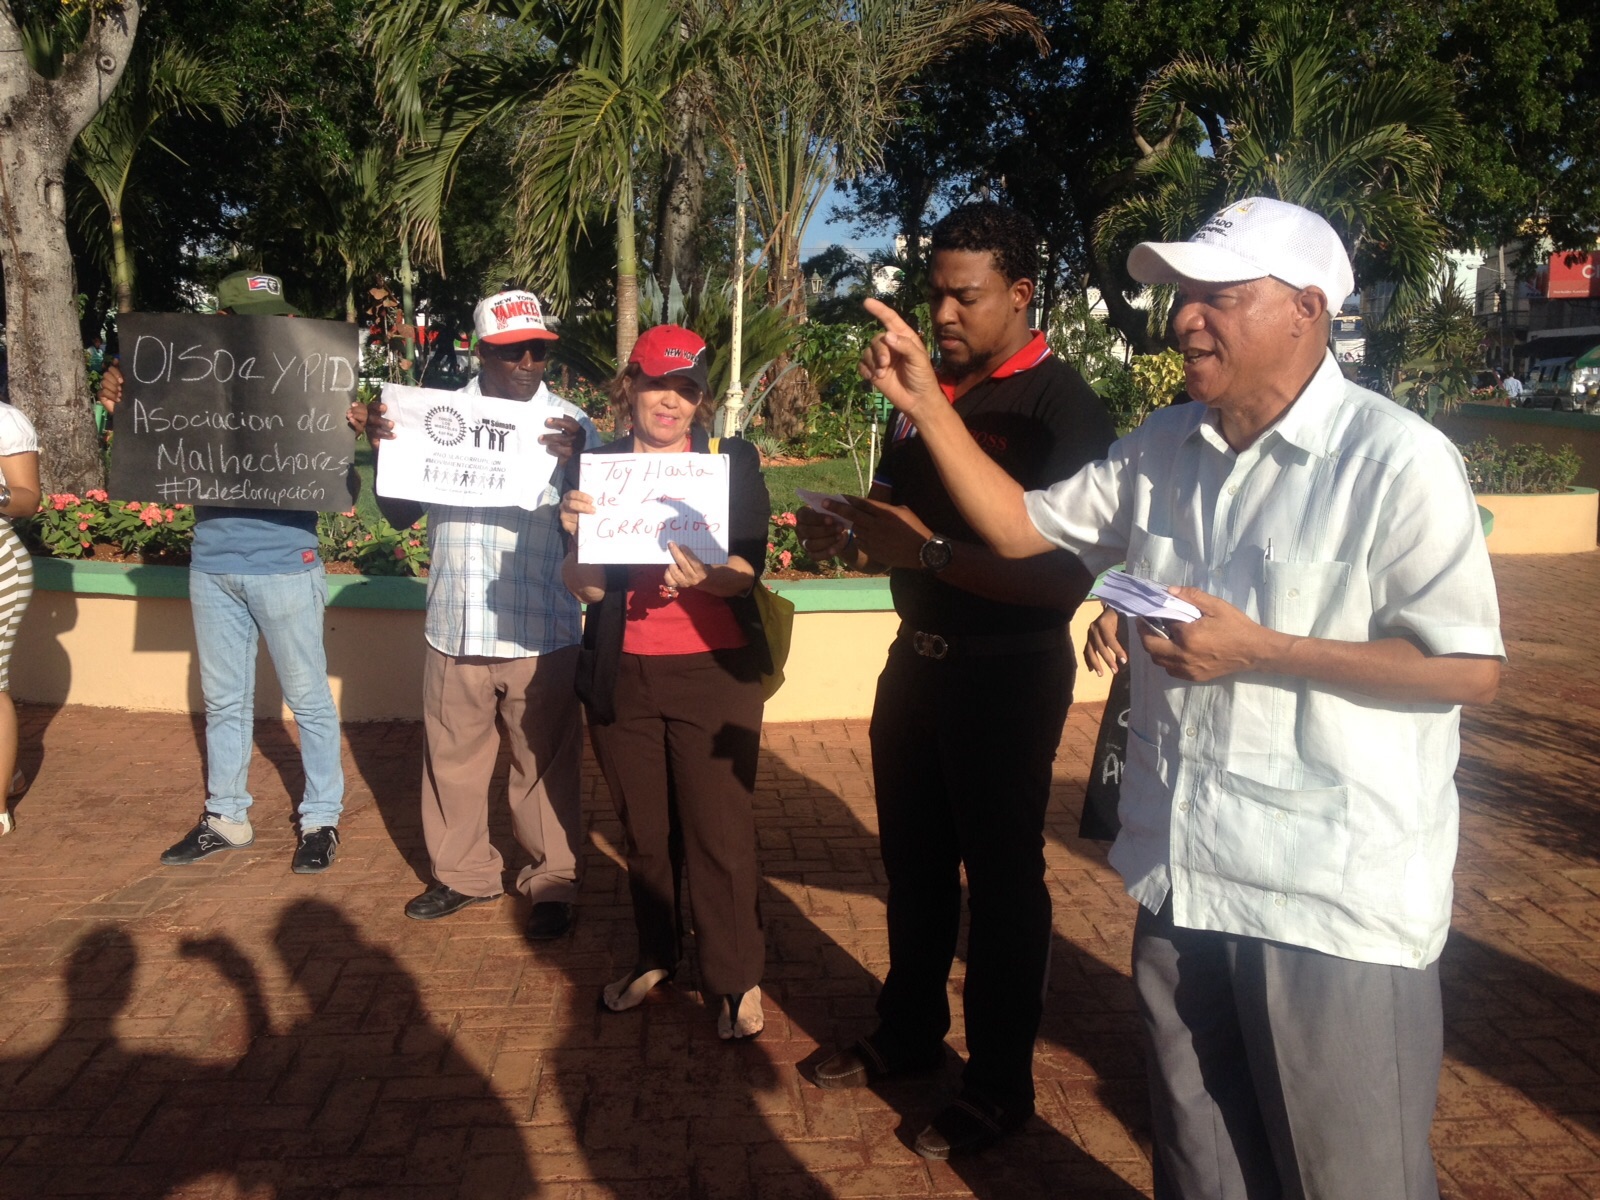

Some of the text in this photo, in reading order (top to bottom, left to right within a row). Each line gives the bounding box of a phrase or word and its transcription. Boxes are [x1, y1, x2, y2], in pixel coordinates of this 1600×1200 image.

[490, 301, 540, 320] YANKEES
[494, 297, 512, 306] NEW
[664, 348, 682, 358] NEW
[297, 408, 337, 434] de
[157, 438, 350, 475] Malhechores
[601, 459, 637, 495] Toy
[597, 492, 619, 506] de
